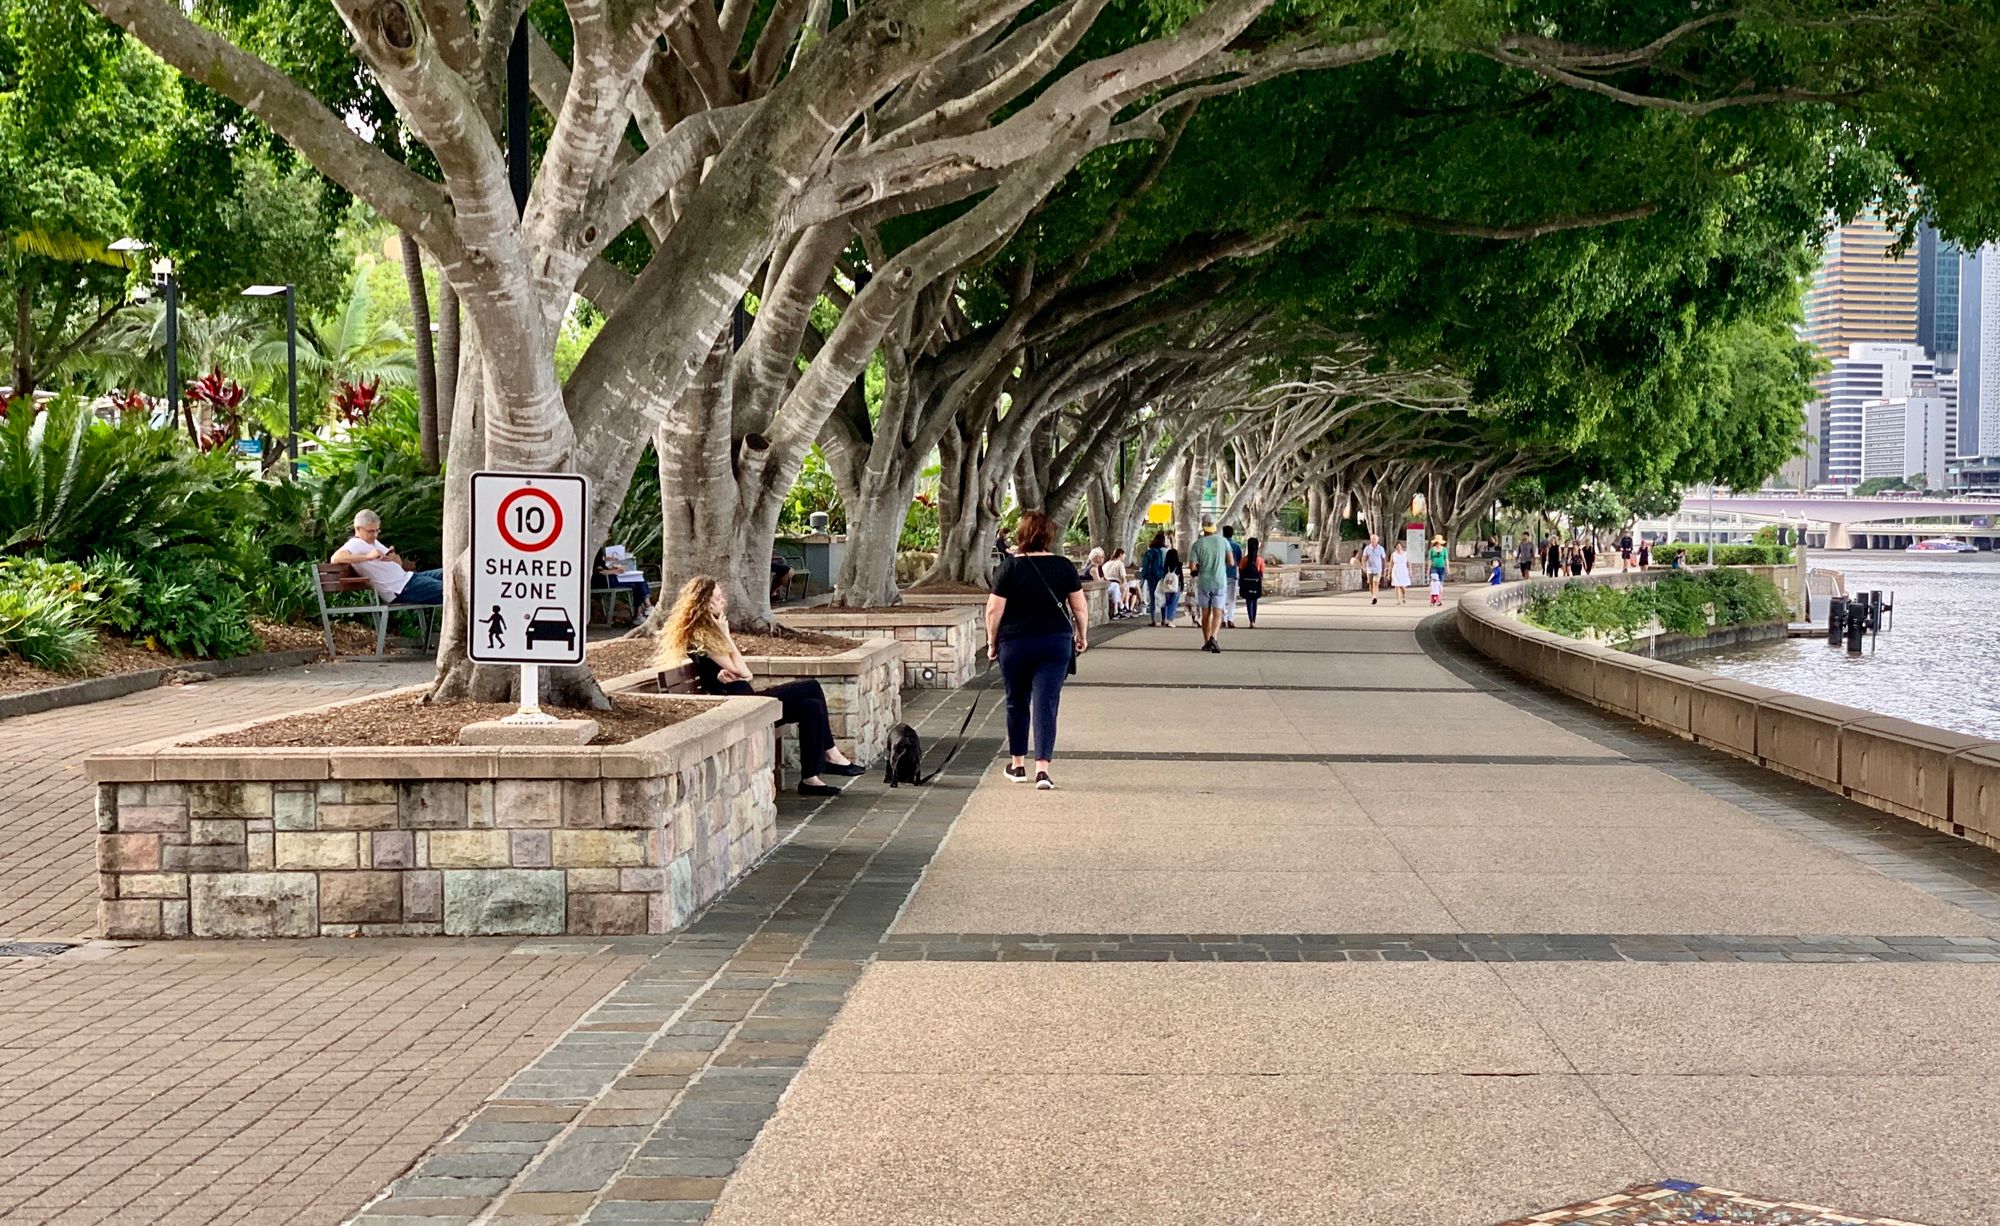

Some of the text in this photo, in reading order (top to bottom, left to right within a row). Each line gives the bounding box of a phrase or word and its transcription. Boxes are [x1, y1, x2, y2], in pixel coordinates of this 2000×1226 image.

[515, 506, 545, 534] 10
[485, 558, 572, 577] SHARED
[500, 581, 557, 600] ZONE
